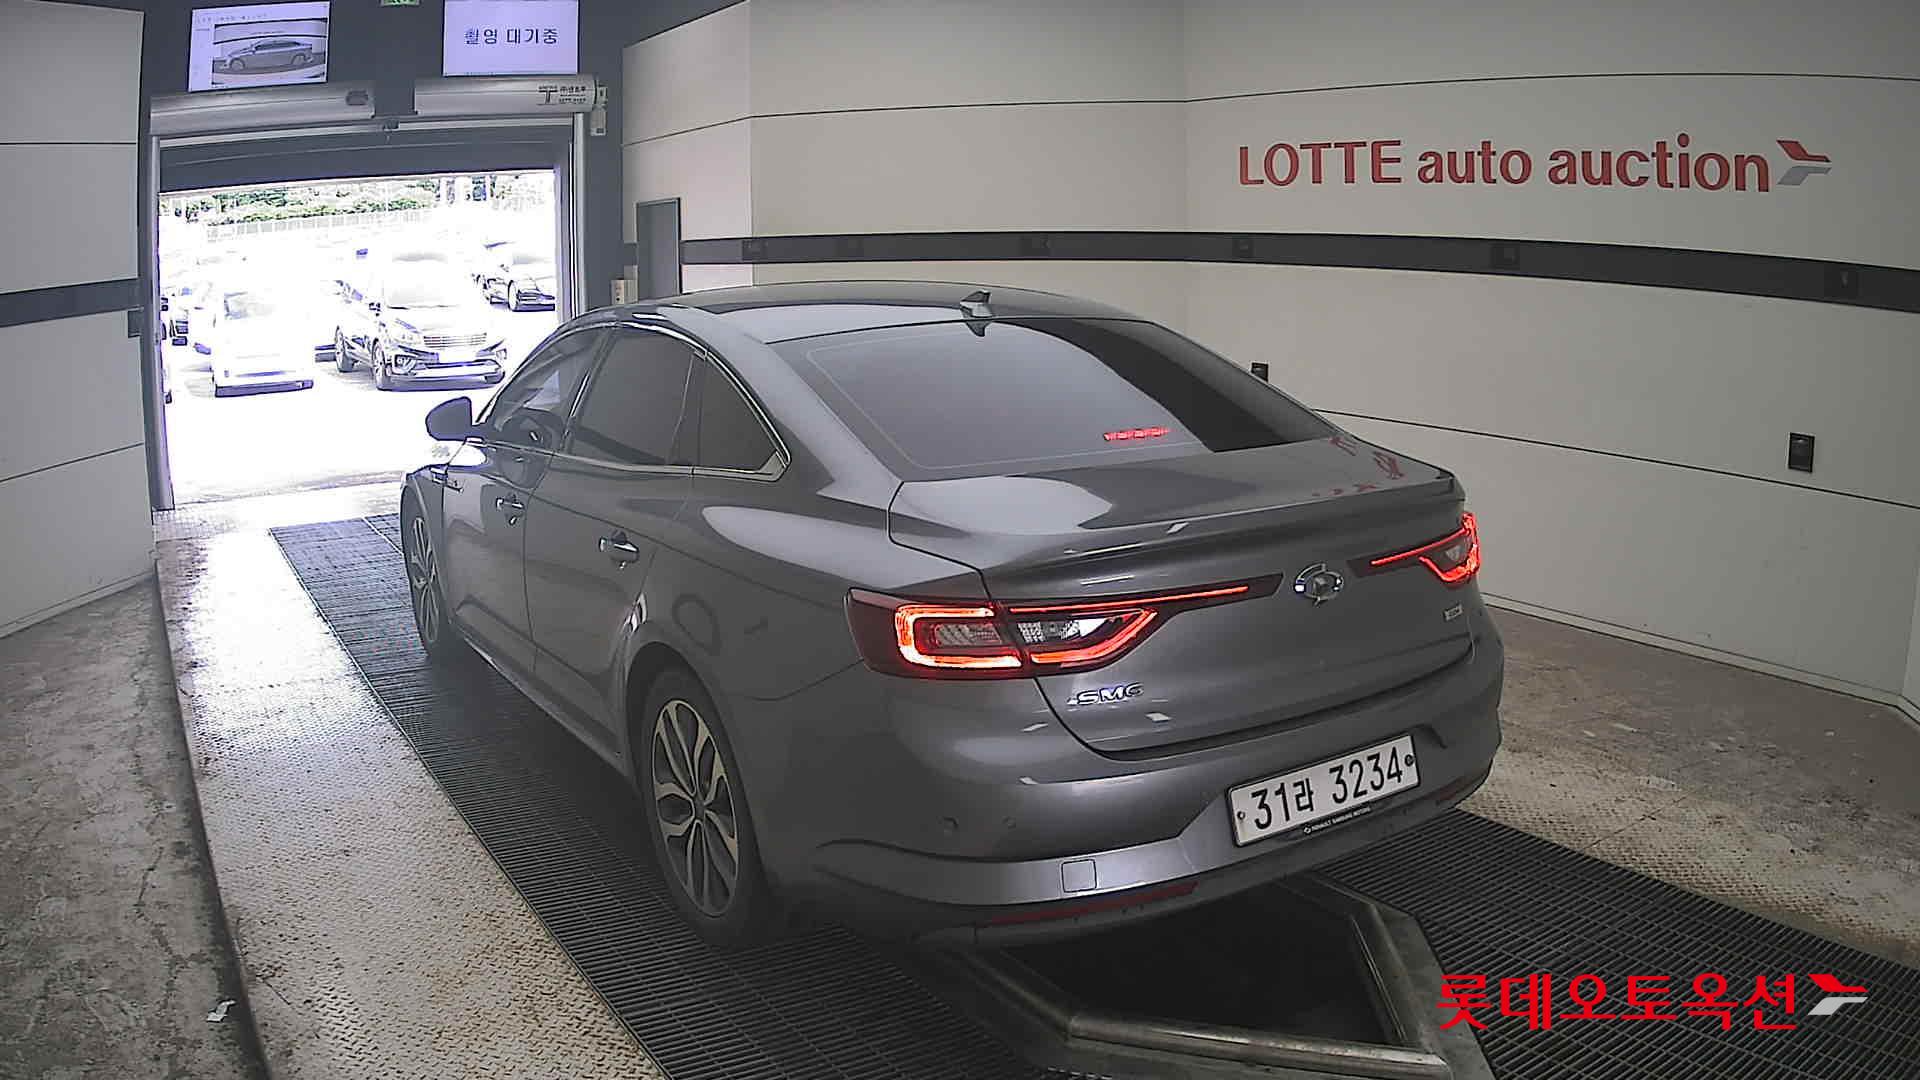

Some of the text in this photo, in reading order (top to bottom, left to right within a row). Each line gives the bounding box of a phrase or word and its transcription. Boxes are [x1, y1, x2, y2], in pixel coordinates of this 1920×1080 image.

[506, 28, 558, 45] 대기중
[1239, 134, 1770, 193] LOTTE auto auction
[1251, 746, 1403, 830] 31라 3234
